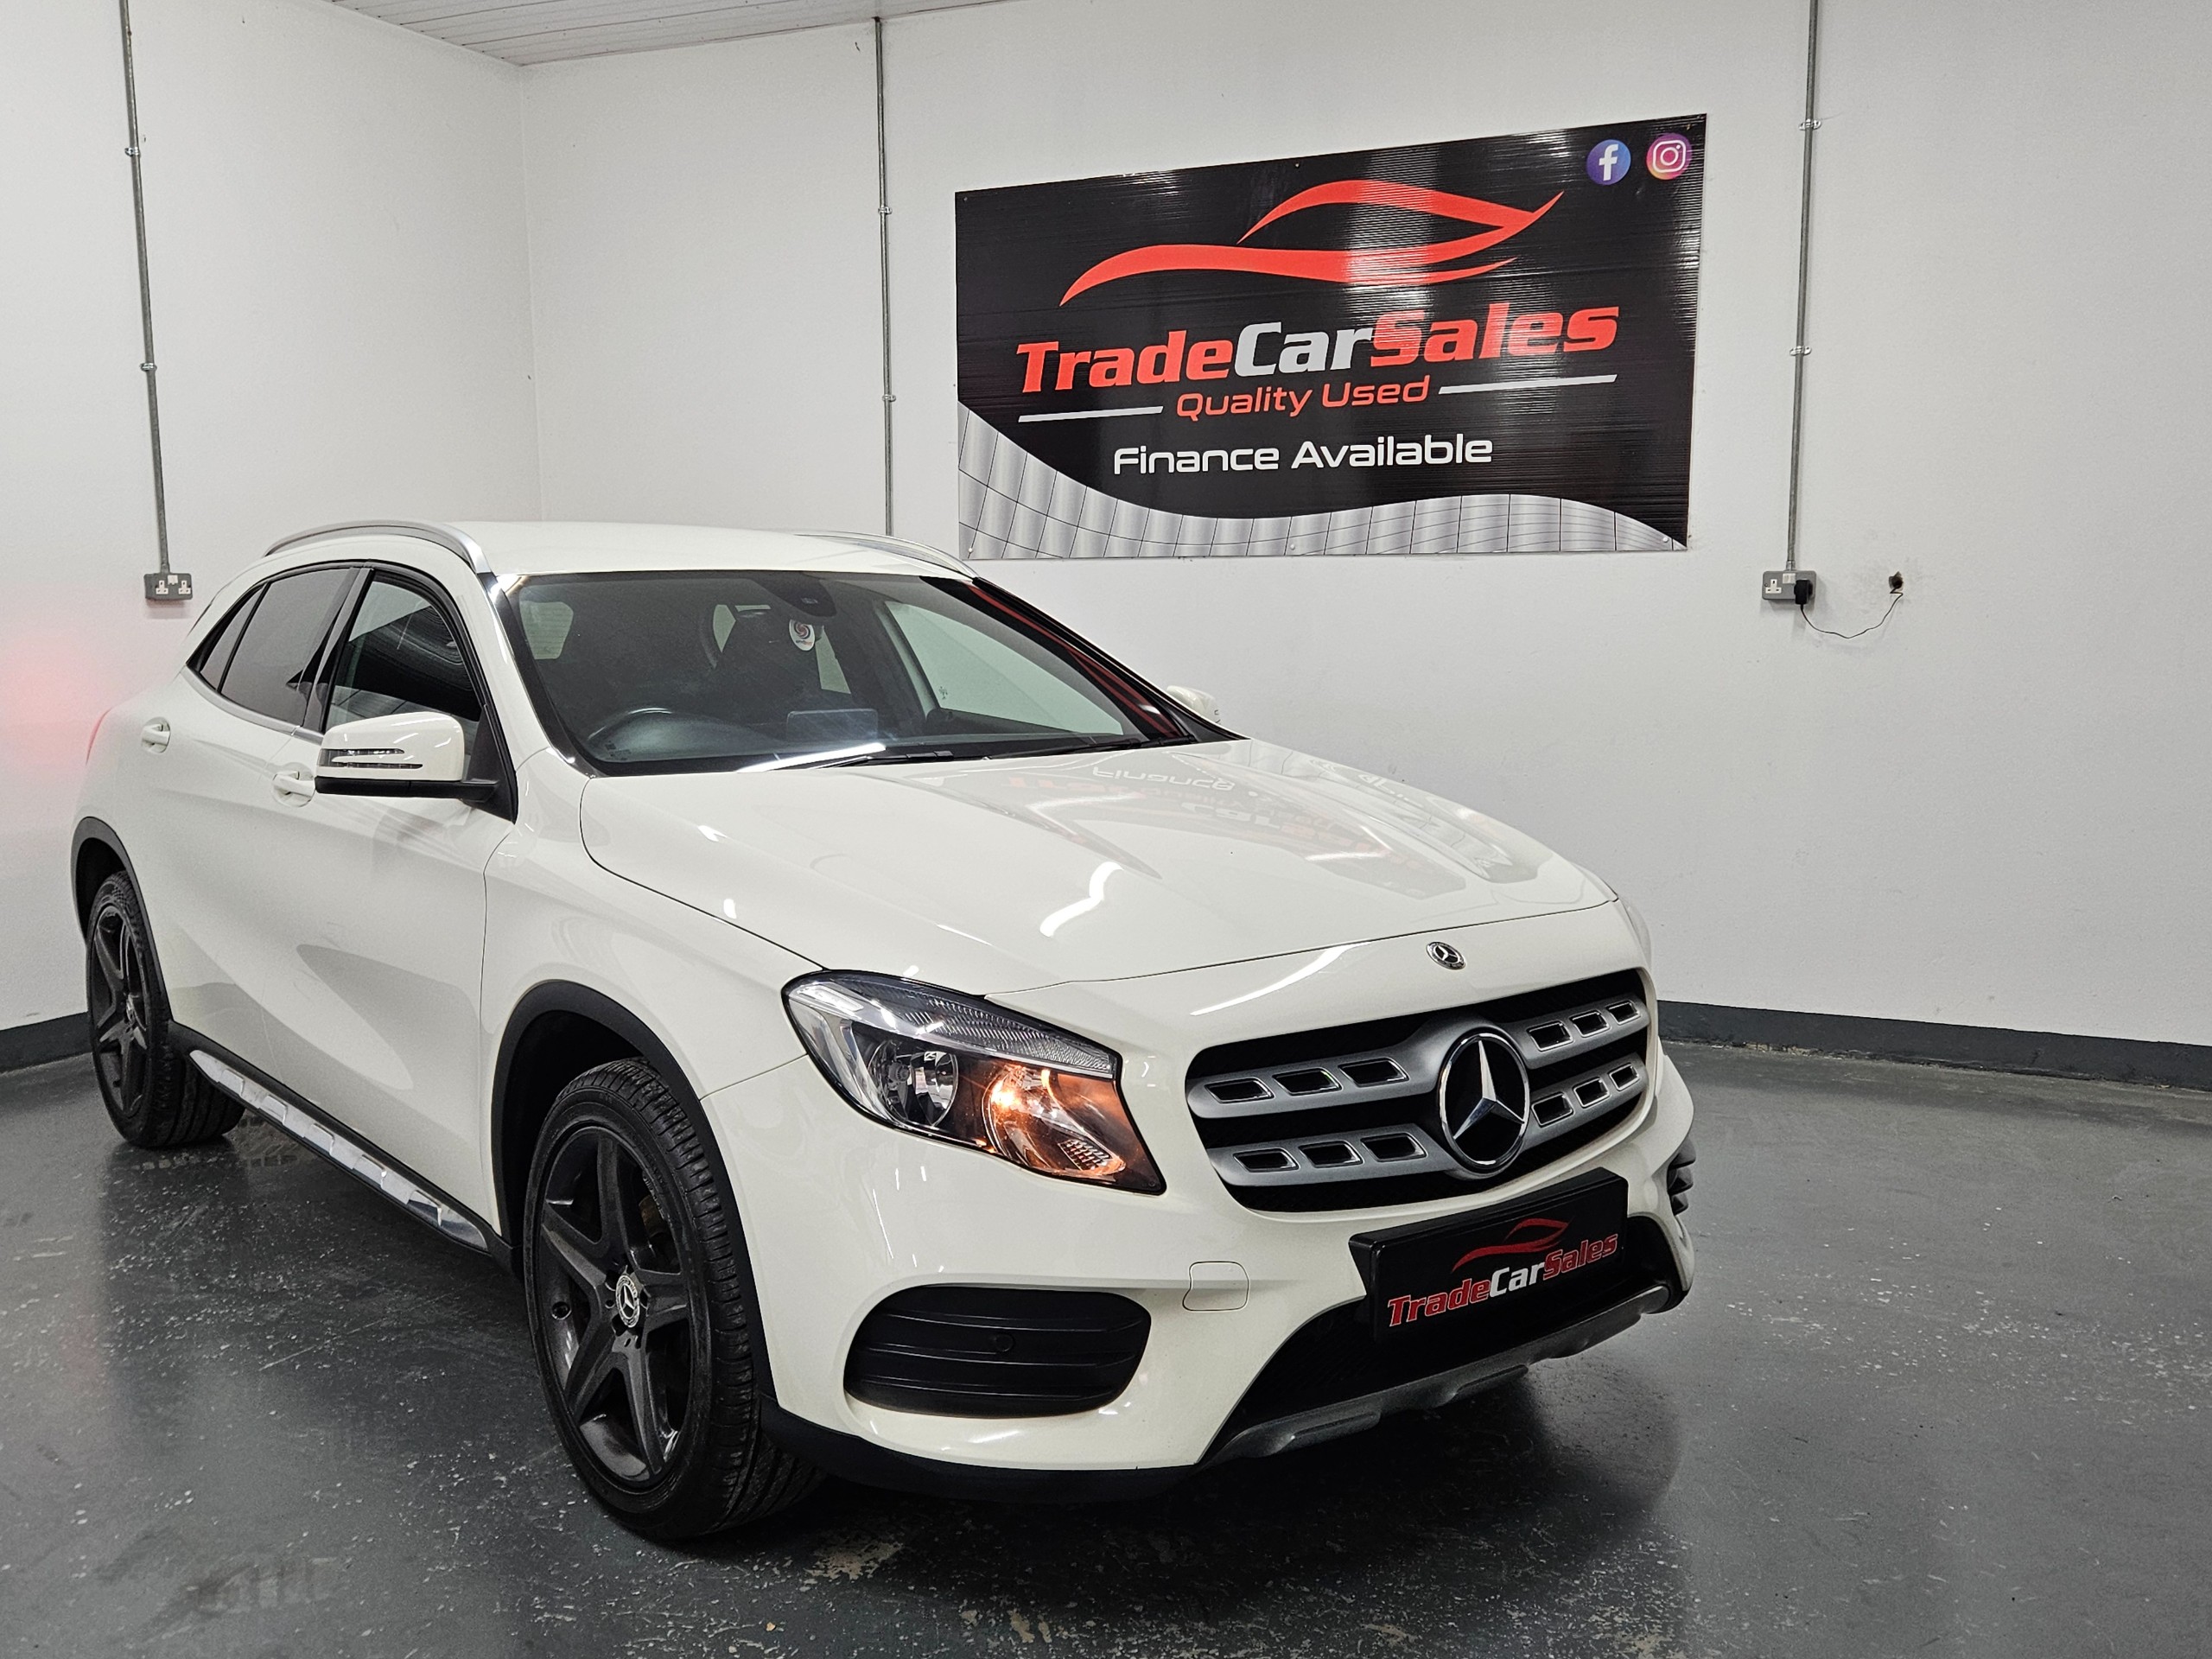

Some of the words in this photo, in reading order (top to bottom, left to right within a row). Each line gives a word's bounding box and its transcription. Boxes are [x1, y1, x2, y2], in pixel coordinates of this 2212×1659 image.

[1016, 302, 1619, 393] TradeCarSales
[1176, 386, 1312, 422] Quality
[1321, 375, 1431, 406] Used
[1112, 445, 1281, 476] Finance
[1291, 433, 1494, 468] Available
[1387, 1233, 1618, 1327] TradeCarSales
